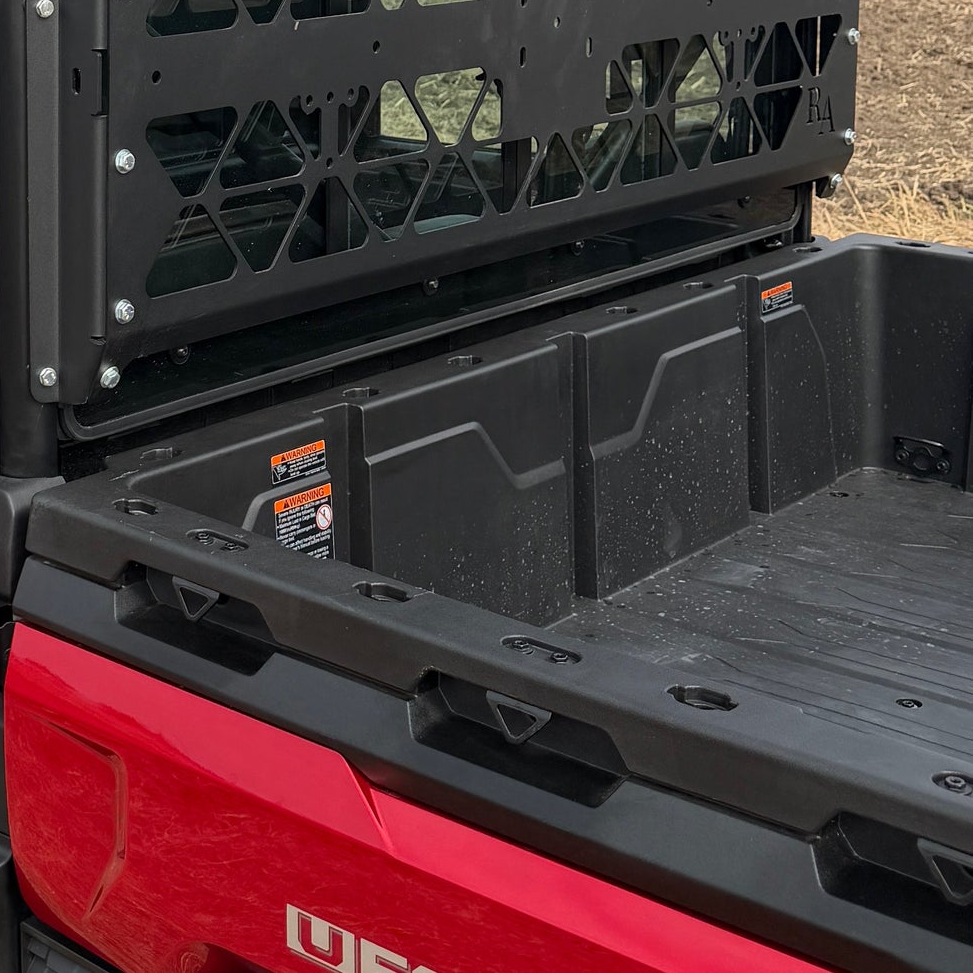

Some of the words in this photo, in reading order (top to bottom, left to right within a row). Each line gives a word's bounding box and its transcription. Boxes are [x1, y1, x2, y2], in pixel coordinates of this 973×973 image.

[806, 87, 835, 135] RA
[285, 443, 317, 460] WARNING
[288, 487, 325, 507] WARNING
[286, 902, 439, 973] UF
